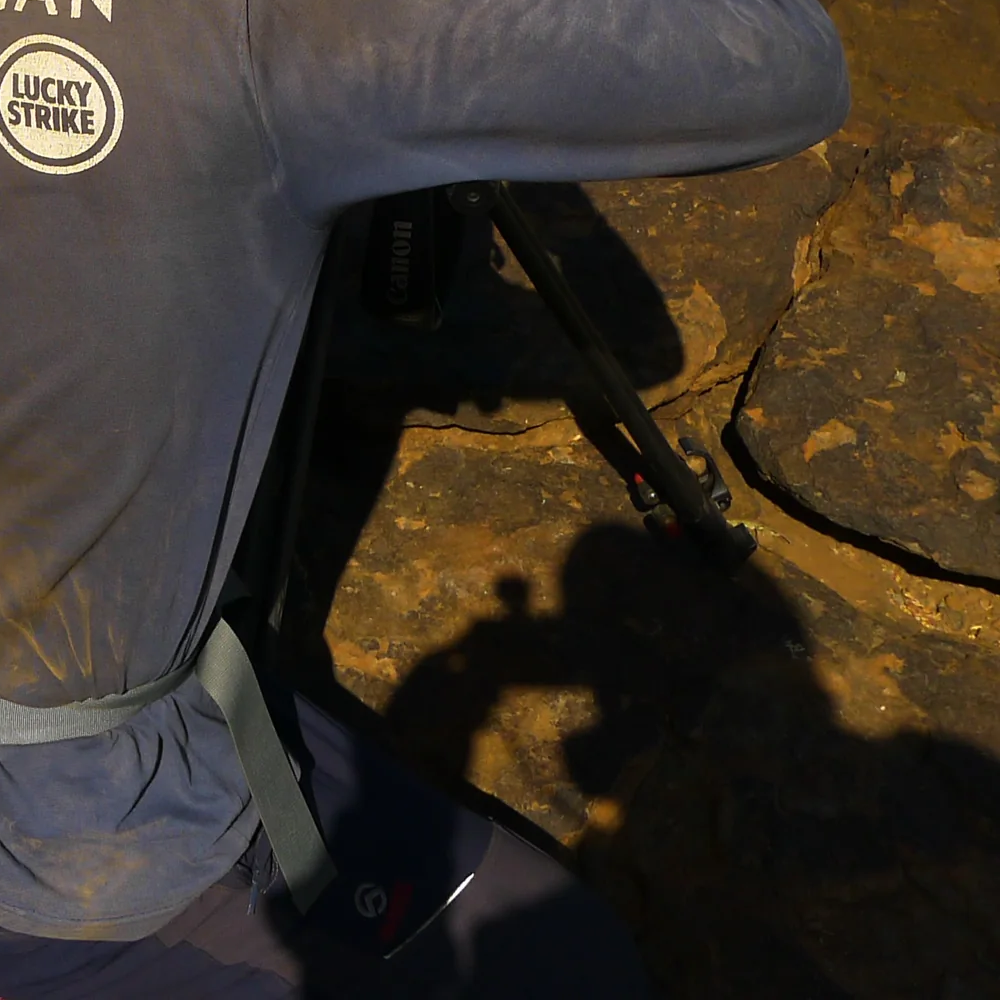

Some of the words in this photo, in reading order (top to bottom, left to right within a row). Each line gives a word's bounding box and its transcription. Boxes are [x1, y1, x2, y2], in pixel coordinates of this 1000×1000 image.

[12, 73, 92, 107] LUCKY
[7, 100, 95, 135] STRIKE
[386, 220, 413, 306] Canon
